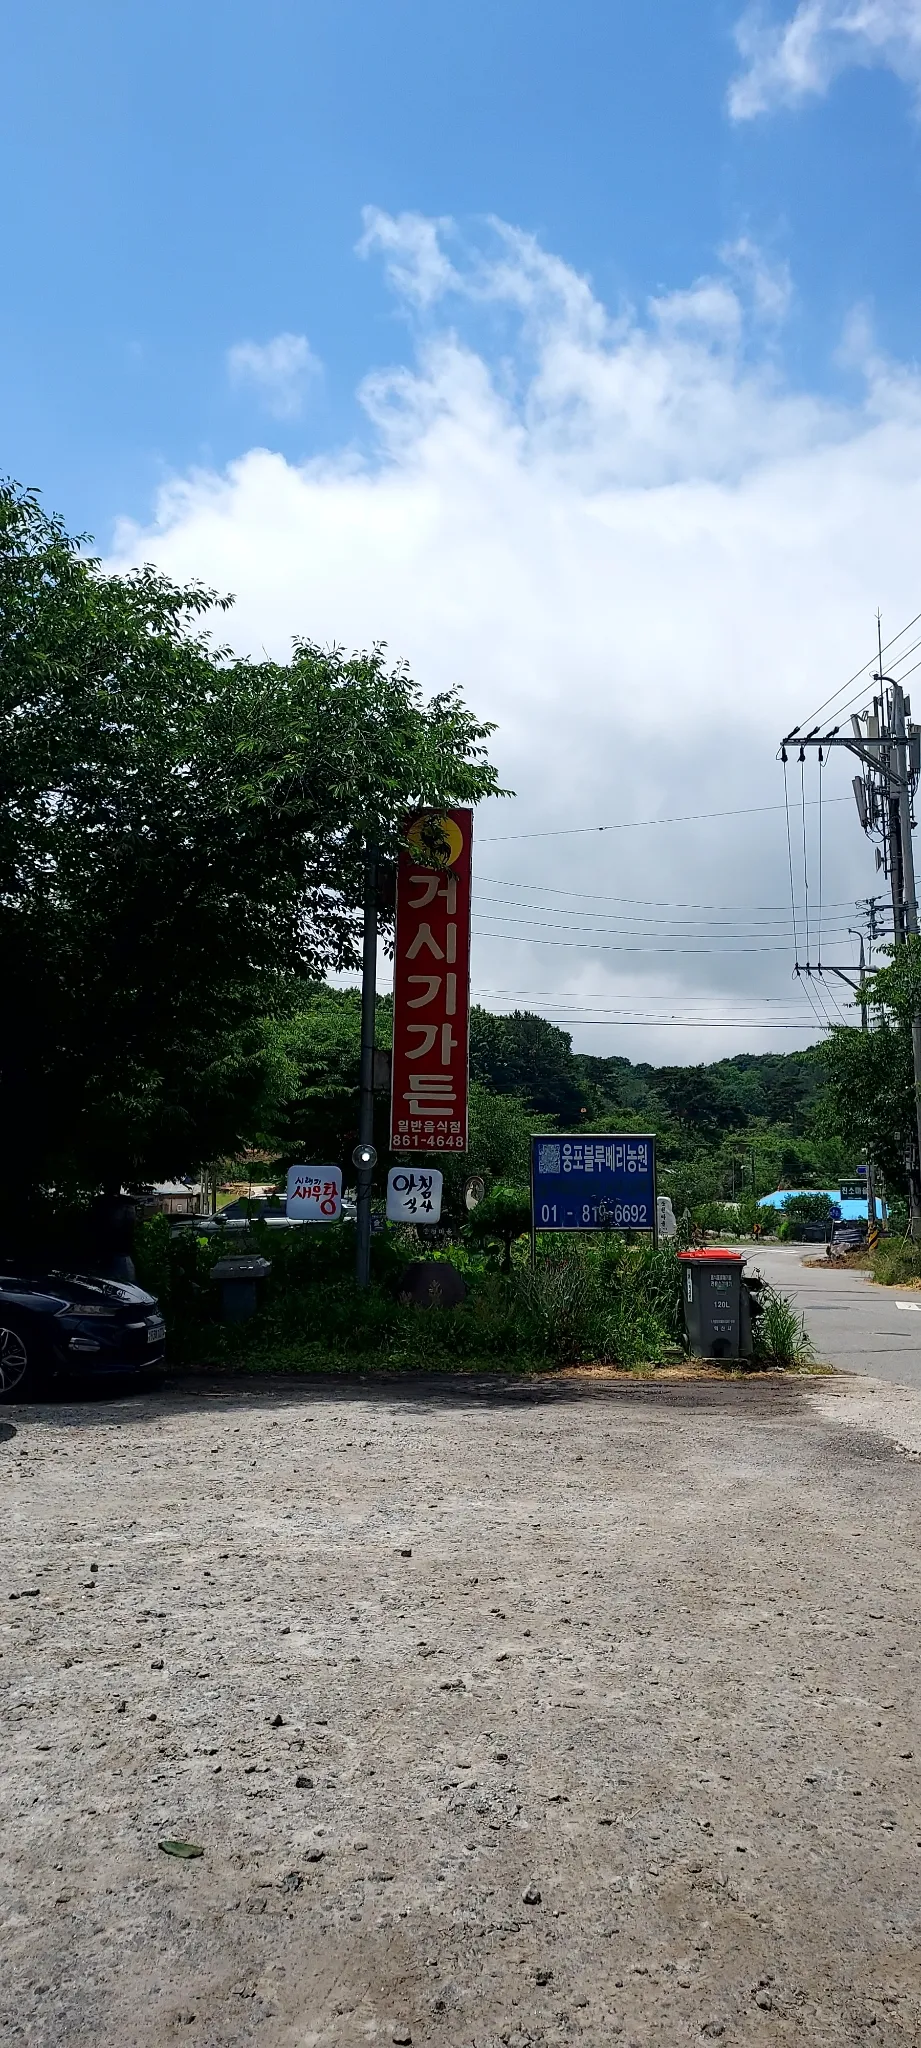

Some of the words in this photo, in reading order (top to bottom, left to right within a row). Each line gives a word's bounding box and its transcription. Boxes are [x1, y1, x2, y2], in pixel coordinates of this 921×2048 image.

[402, 875, 458, 1116] 거시기가든
[398, 1120, 461, 1134] 일반음식점
[392, 1135, 464, 1148] 861-4648
[561, 1143, 648, 1172] 웅포블루베리농원
[295, 1176, 322, 1185] 시래기
[392, 1173, 433, 1200] 아침
[290, 1181, 339, 1216] 새우탕
[402, 1196, 434, 1215] 식사
